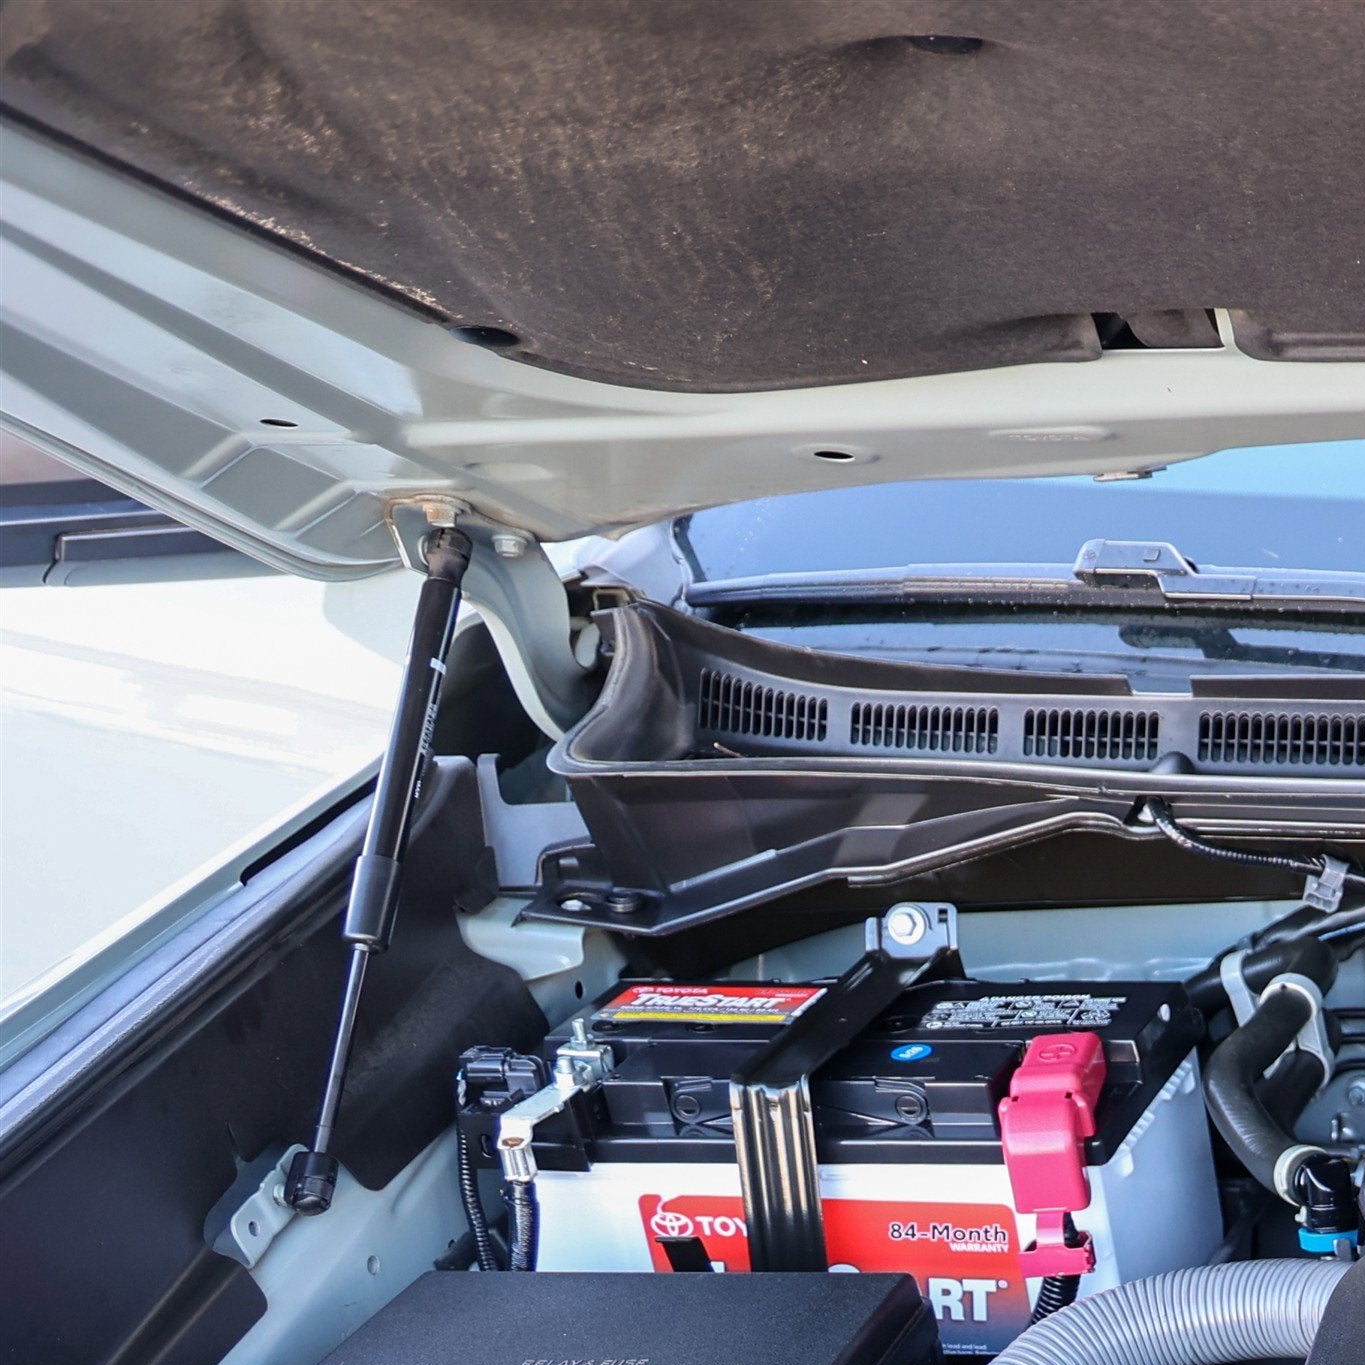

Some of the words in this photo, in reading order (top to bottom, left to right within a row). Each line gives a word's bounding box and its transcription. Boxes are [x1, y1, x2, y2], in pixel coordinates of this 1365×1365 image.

[695, 1216, 748, 1237] TOY
[889, 1222, 1008, 1242] 84-Month
[949, 1243, 1009, 1253] WARRANTY
